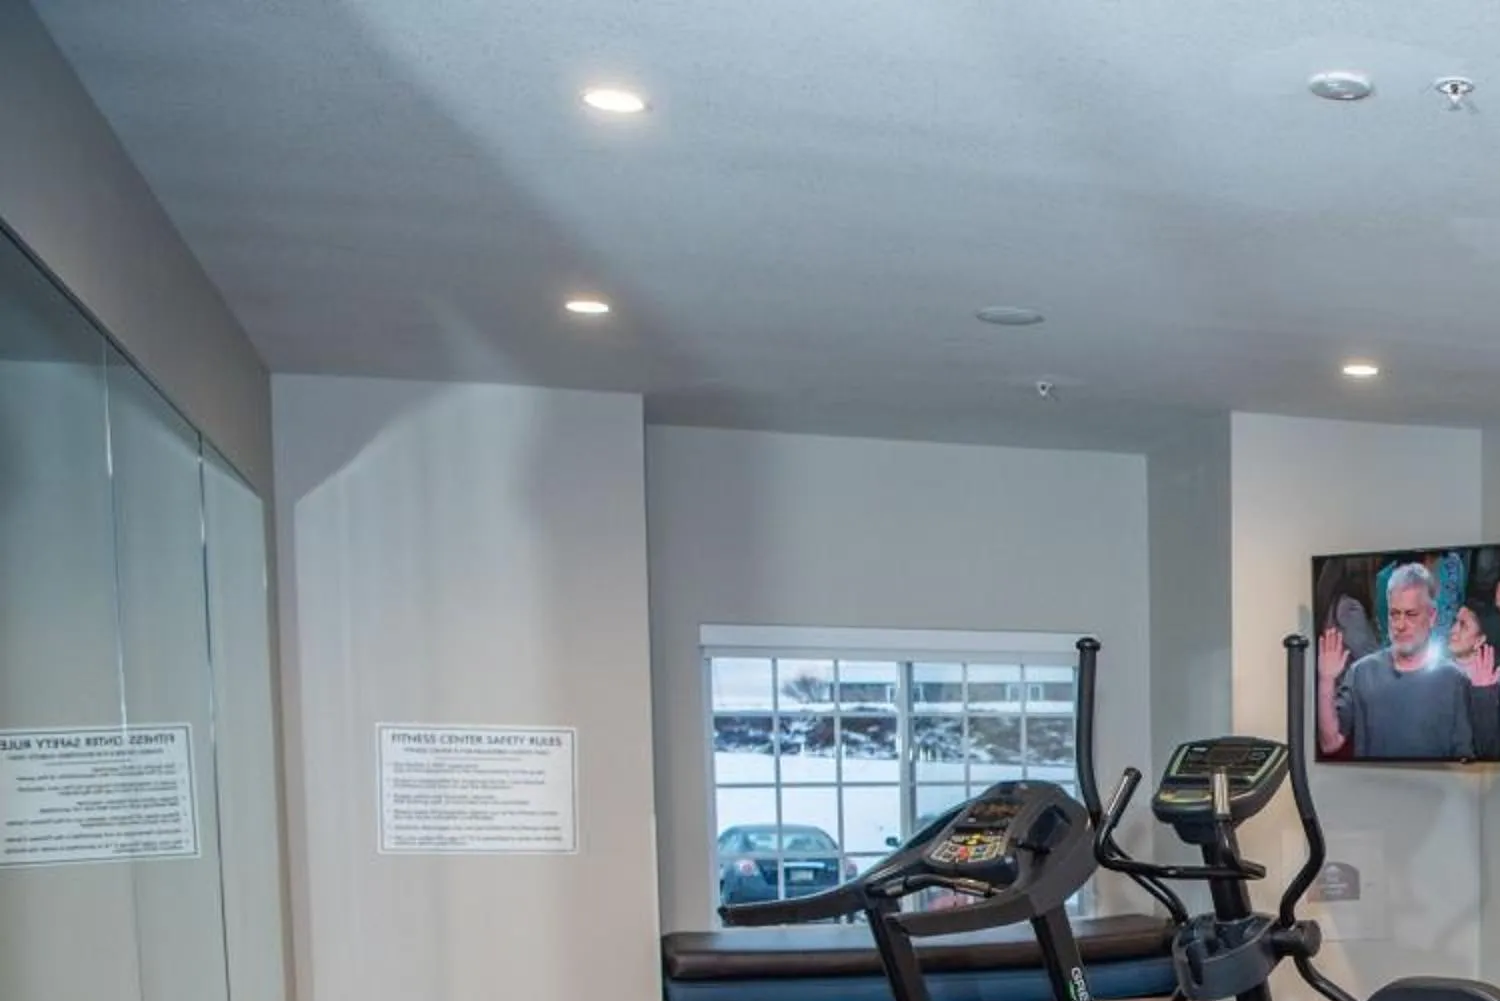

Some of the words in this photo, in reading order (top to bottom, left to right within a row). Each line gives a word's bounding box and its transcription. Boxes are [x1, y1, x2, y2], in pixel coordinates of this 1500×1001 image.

[391, 732, 436, 745] FITNESS
[440, 733, 483, 746] CENTER
[487, 734, 525, 746] SAFETY
[529, 735, 562, 747] RULES
